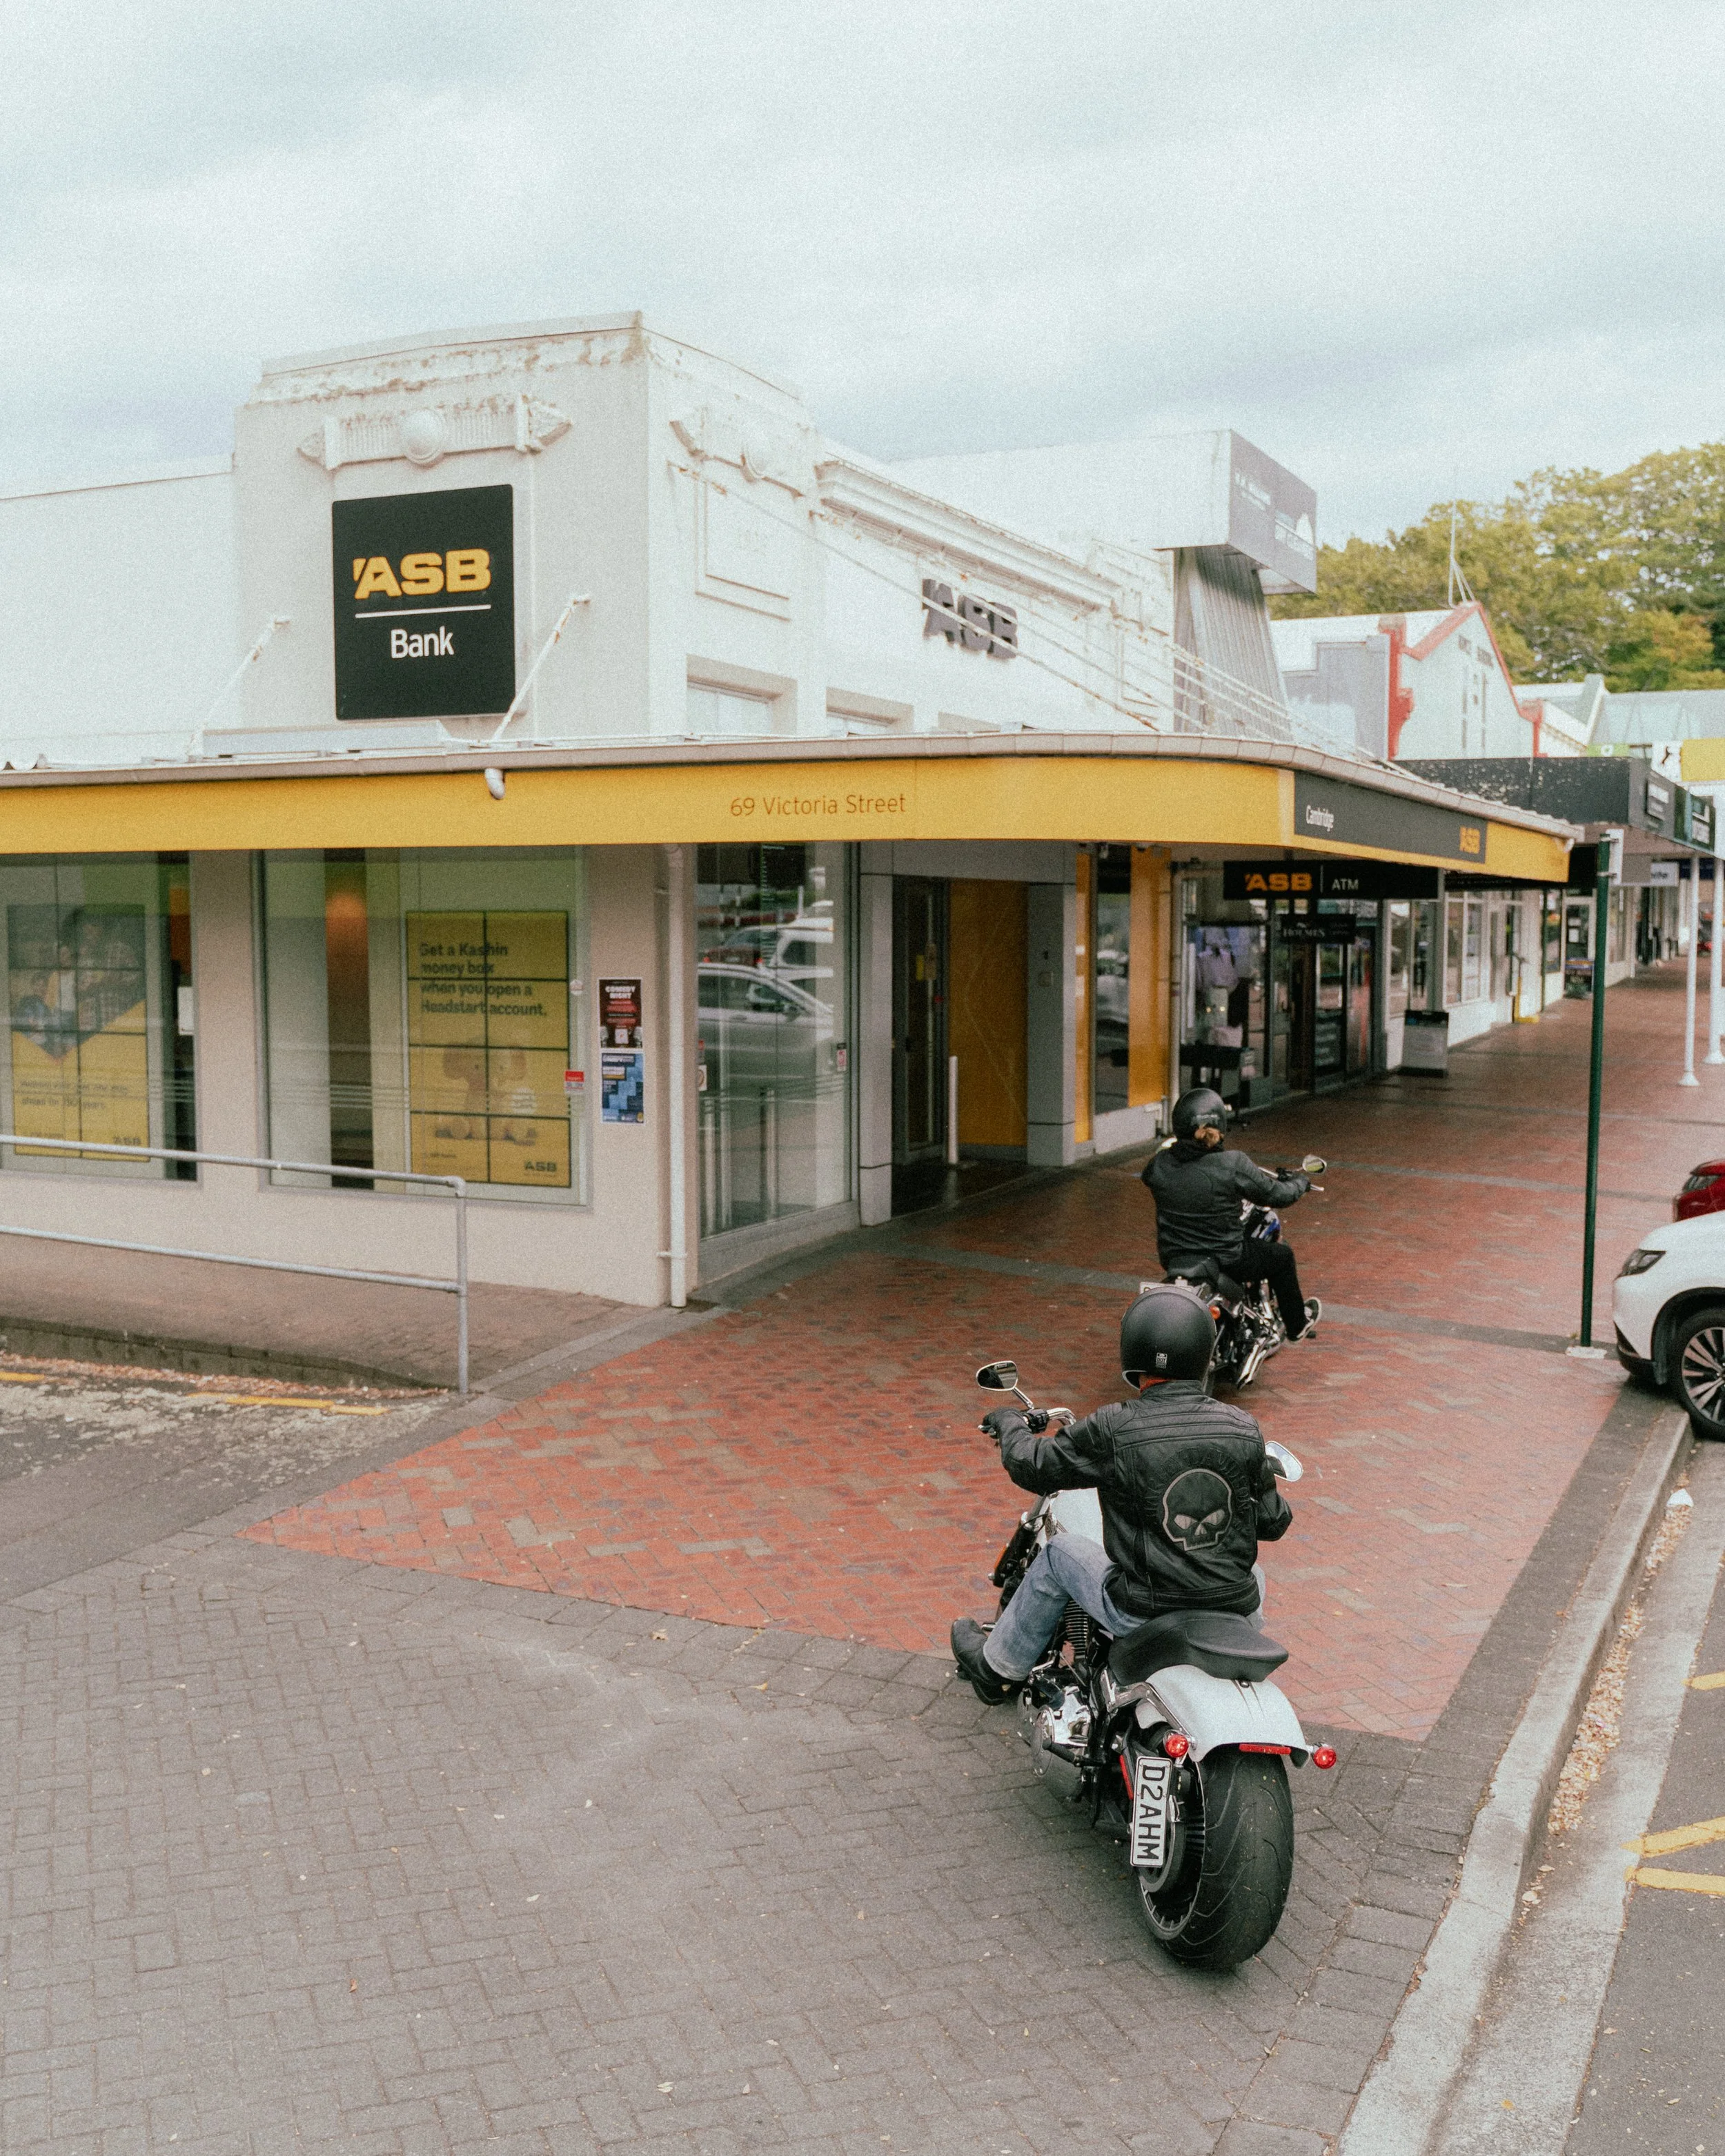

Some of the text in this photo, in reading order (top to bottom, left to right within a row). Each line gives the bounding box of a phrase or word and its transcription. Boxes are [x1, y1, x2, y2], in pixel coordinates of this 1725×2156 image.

[353, 548, 491, 600] ASB
[391, 626, 454, 658] Bank
[731, 793, 906, 816] 69 Victoria Street
[1306, 804, 1334, 832] Cambridge
[1244, 872, 1359, 892] ASB ATM
[420, 942, 443, 956] Get
[448, 946, 455, 956] a
[421, 962, 464, 978] money
[421, 980, 533, 999] when you open a
[524, 1160, 558, 1172] ASB
[1137, 1765, 1166, 1860] D2AHM
